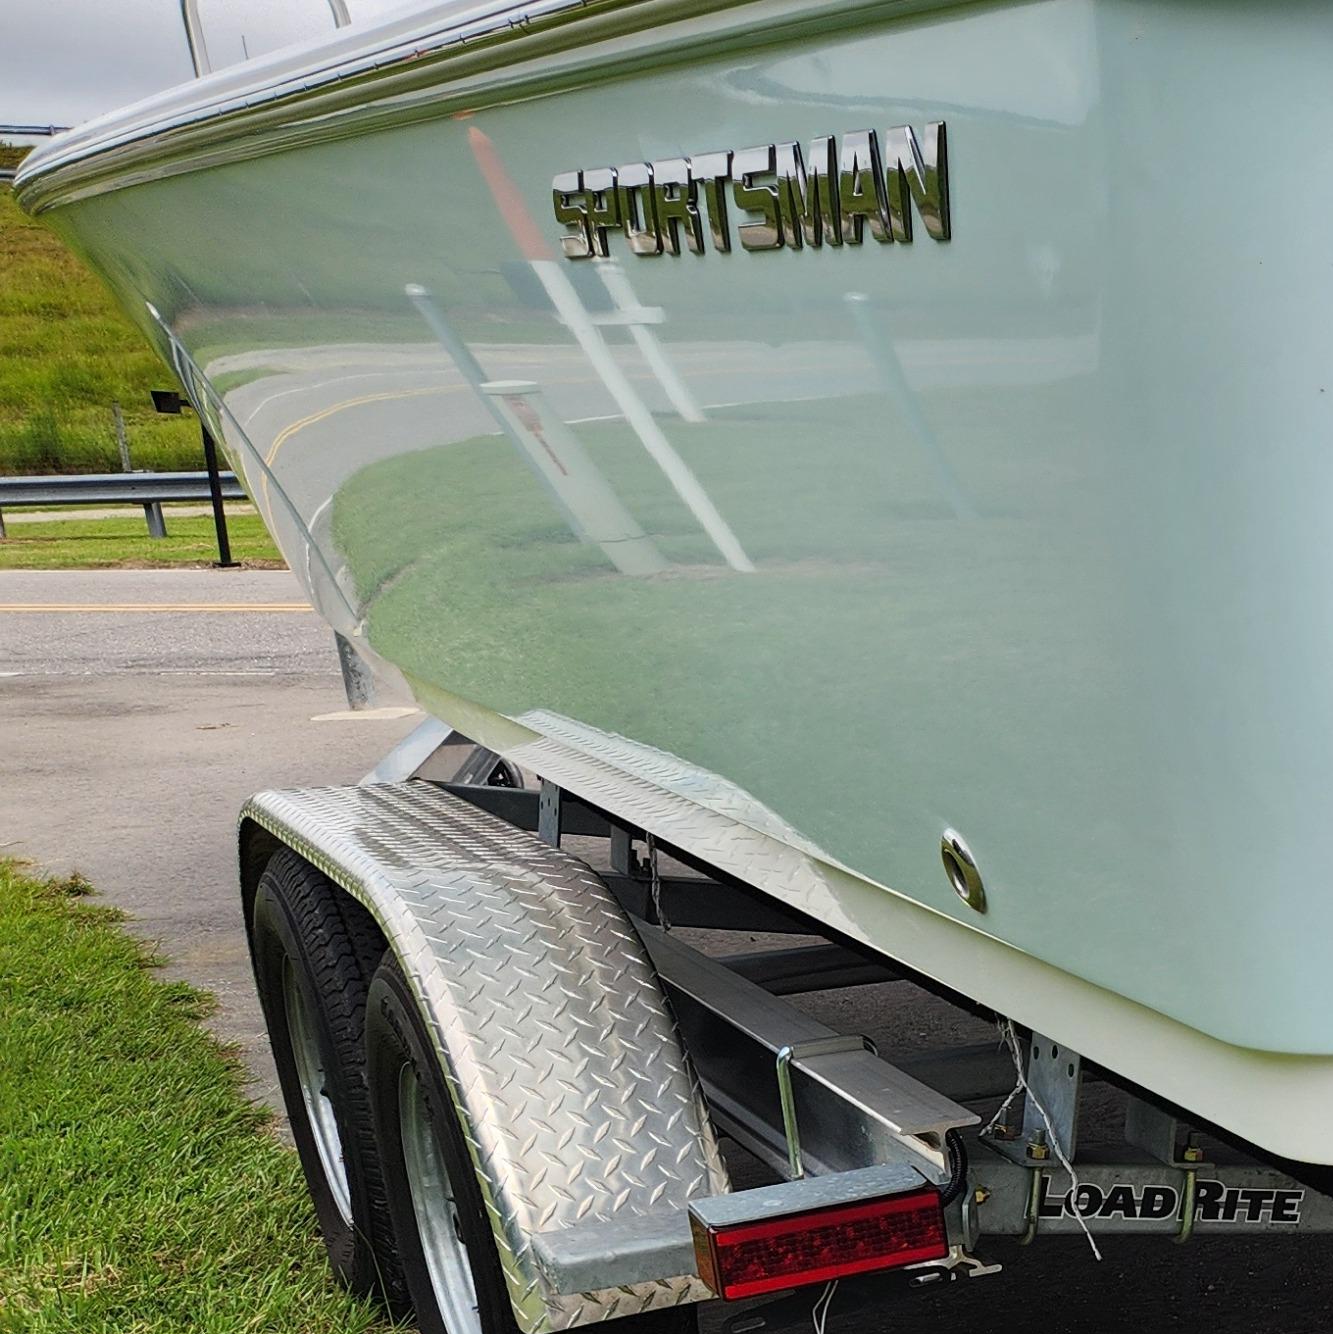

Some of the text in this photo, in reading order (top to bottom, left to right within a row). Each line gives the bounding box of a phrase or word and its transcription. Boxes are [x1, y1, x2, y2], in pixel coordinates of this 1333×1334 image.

[552, 120, 951, 259] SPORTSMAN
[1025, 1175, 1305, 1223] LOAD RITE
